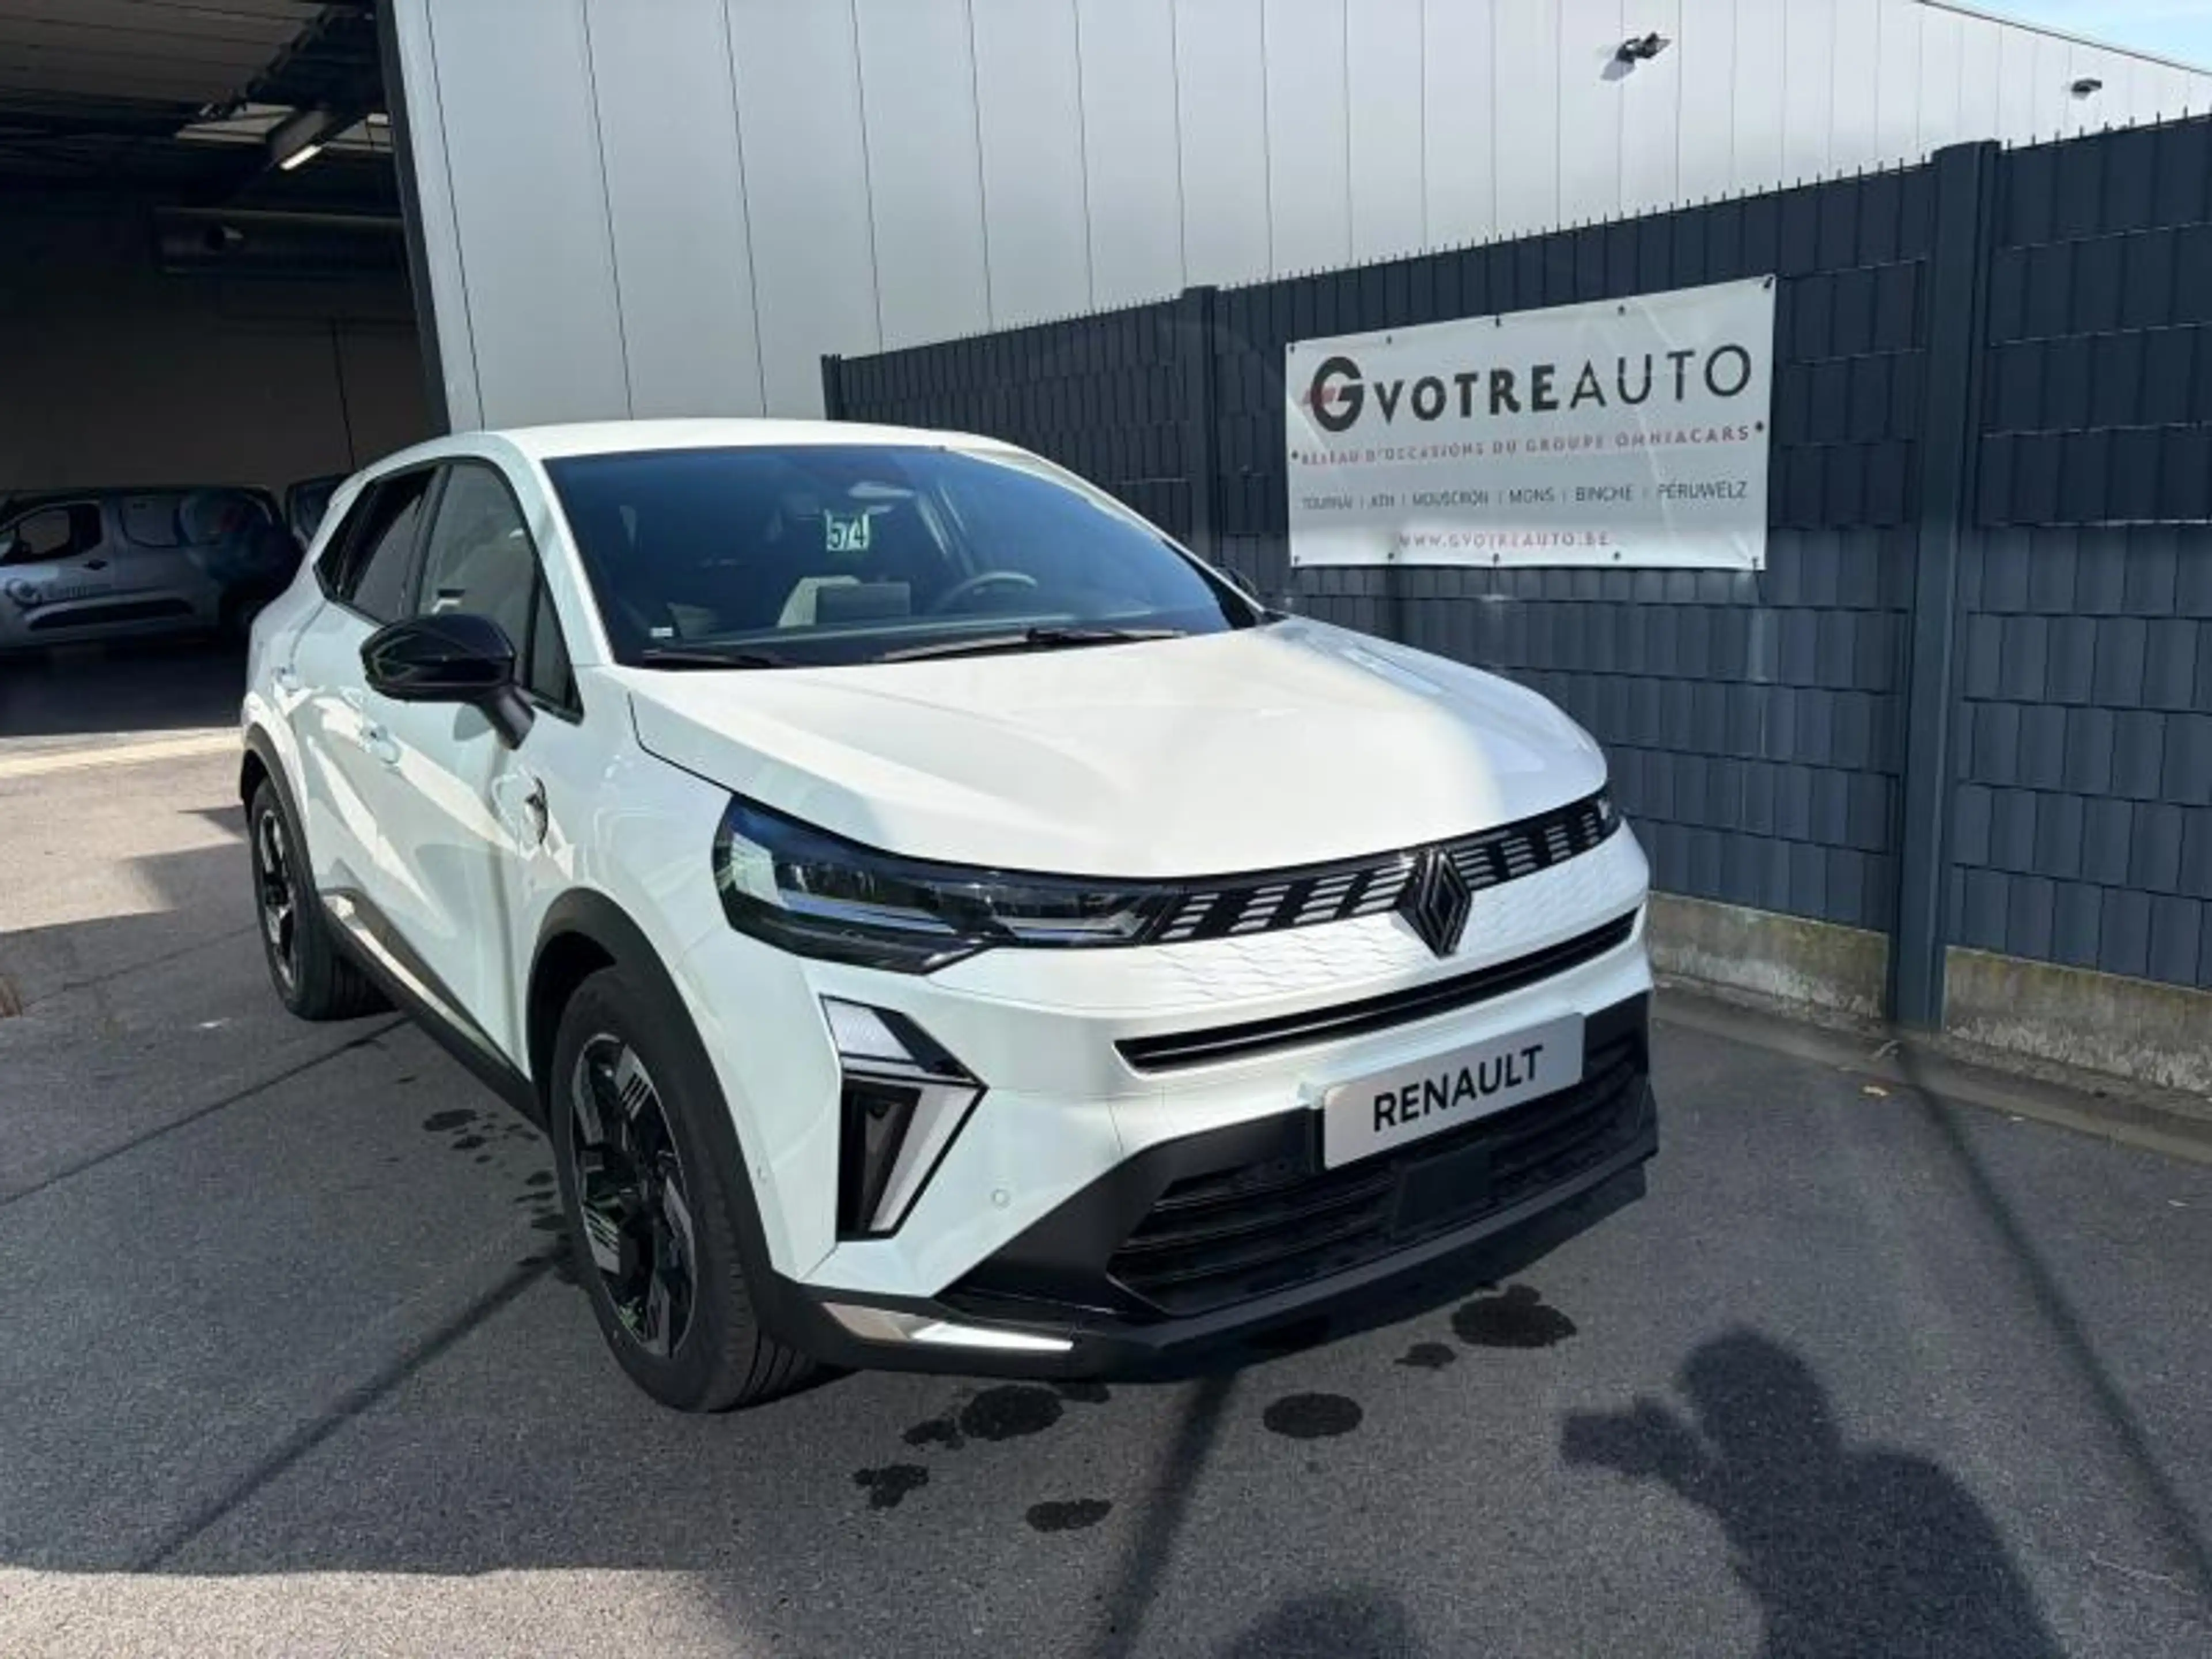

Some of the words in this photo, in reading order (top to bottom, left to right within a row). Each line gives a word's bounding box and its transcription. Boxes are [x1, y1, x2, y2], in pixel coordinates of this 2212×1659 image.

[1493, 441, 1517, 454] DU
[1526, 434, 1603, 453] GROUPE
[1615, 425, 1749, 448] OMNIACARS
[1509, 487, 1555, 504] MONS
[1575, 484, 1634, 502] BINCHE
[1374, 1045, 1544, 1132] RENAULT
